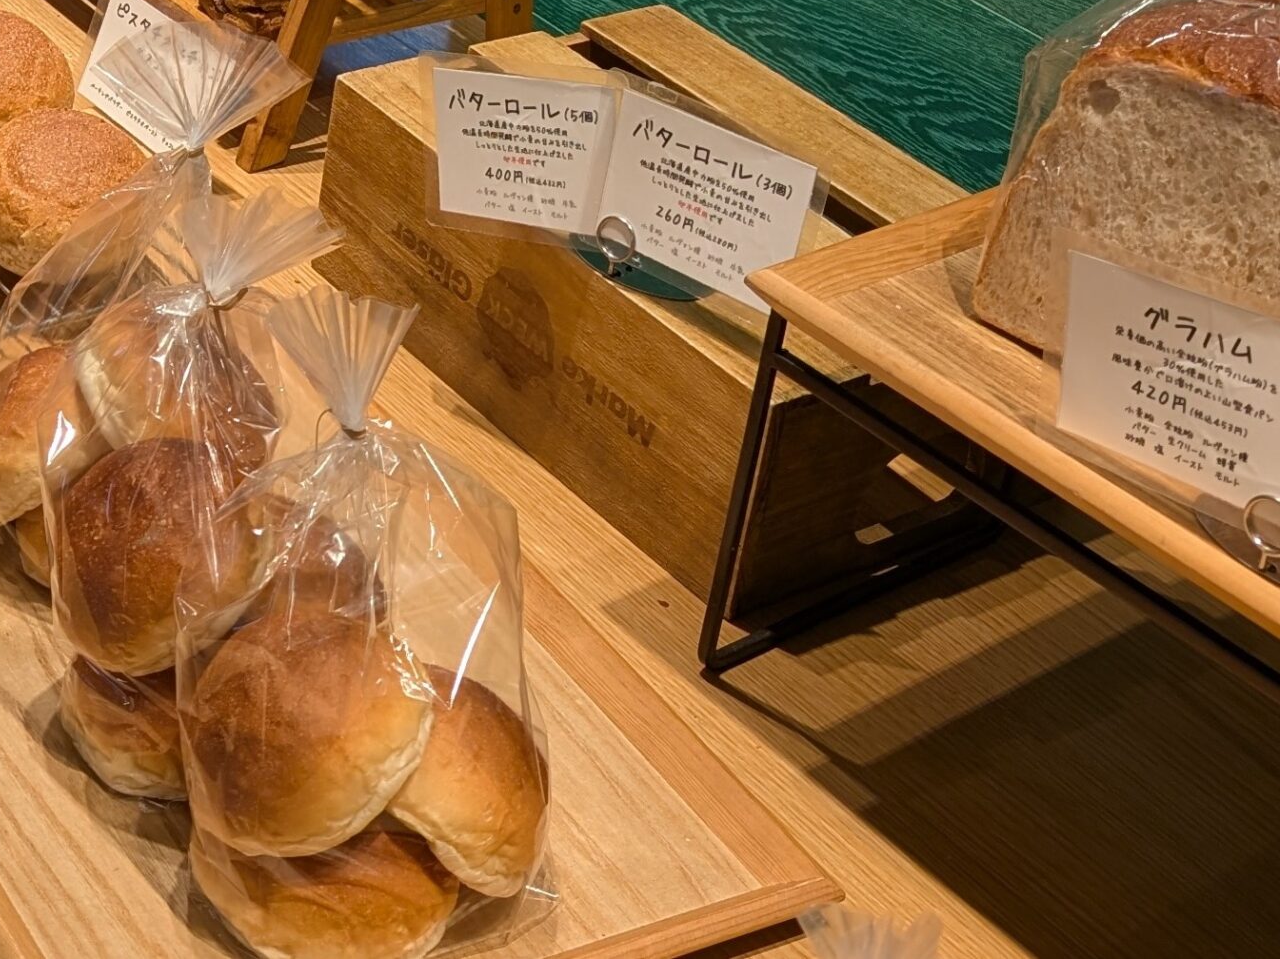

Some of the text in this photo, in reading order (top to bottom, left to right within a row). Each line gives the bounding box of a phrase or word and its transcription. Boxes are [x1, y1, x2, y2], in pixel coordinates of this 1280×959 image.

[449, 88, 599, 125] バターロール(5個)
[632, 119, 793, 201] バターロール(3個)
[1144, 307, 1253, 365] グラハム
[1163, 358, 1224, 389] 30%使用した
[1131, 380, 1248, 439] 420円(税込453円)
[1132, 422, 1157, 436] バター
[1174, 454, 1204, 472] イースト
